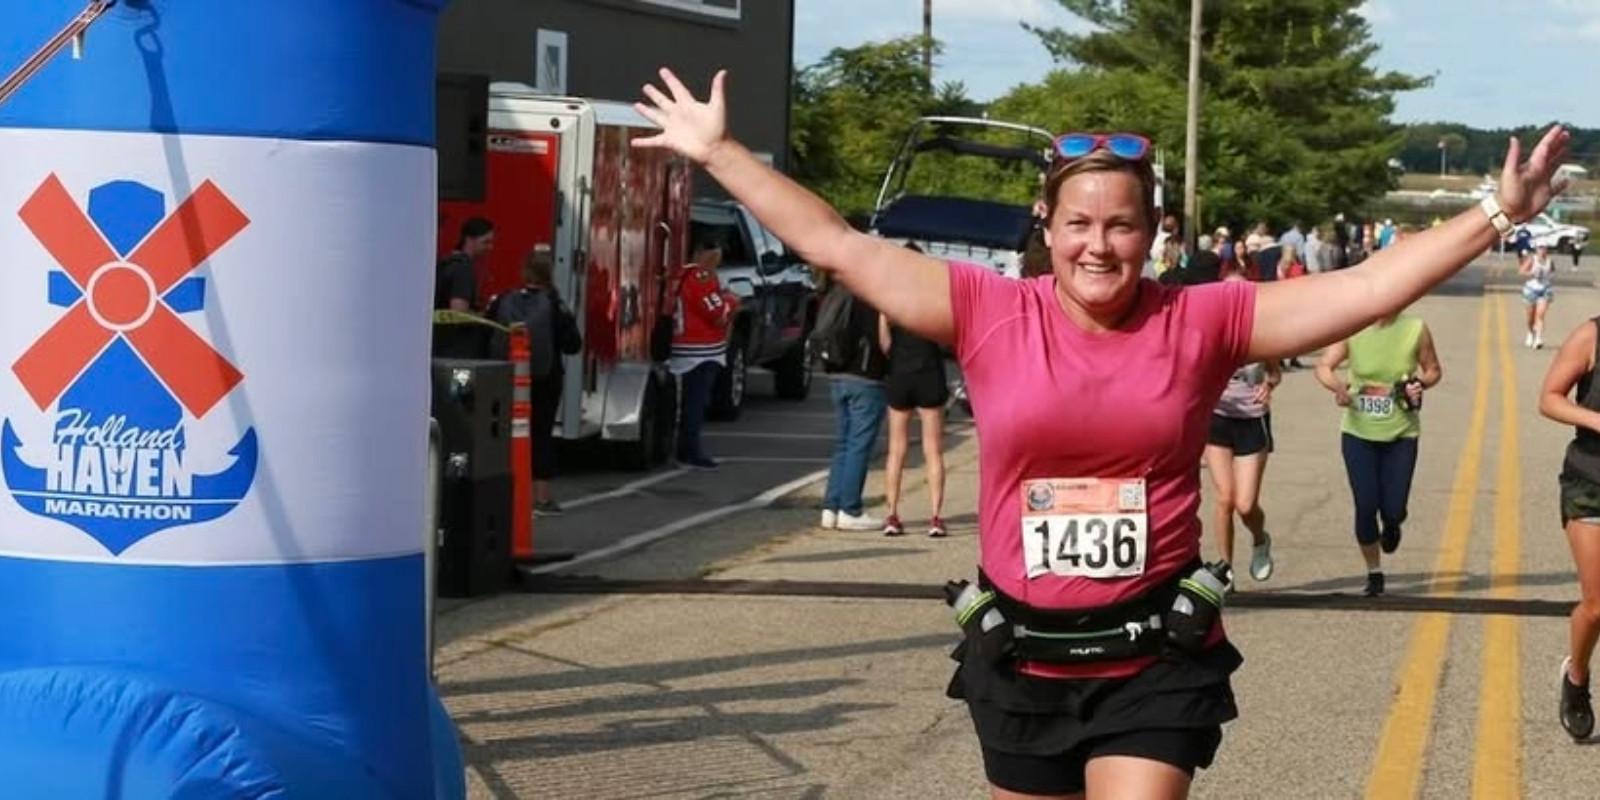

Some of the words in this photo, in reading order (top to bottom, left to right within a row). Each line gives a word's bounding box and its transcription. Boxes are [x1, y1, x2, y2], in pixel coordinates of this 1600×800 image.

[1360, 397, 1391, 414] 1398
[55, 409, 184, 450] Holland
[46, 444, 192, 497] HAVEN
[45, 500, 192, 520] MARATHON
[1035, 518, 1137, 569] 1436
